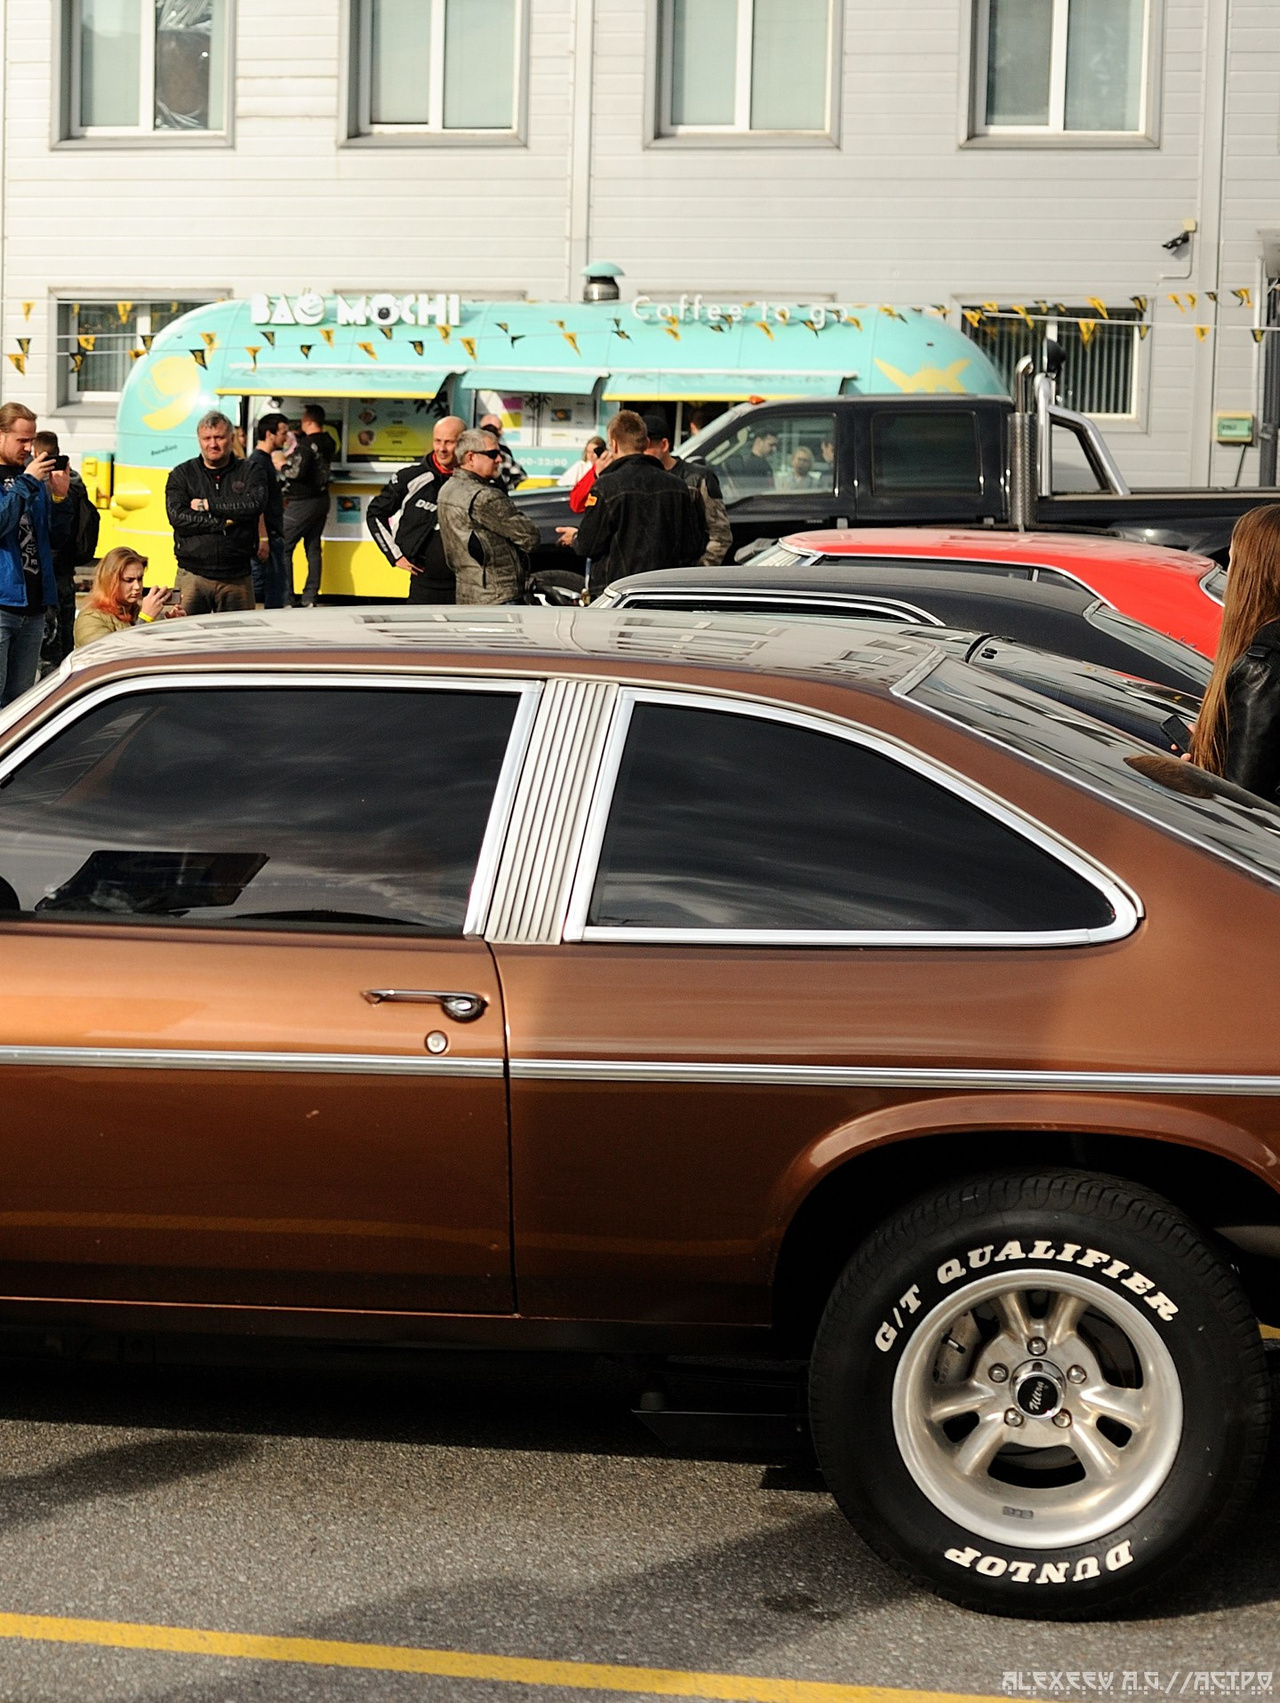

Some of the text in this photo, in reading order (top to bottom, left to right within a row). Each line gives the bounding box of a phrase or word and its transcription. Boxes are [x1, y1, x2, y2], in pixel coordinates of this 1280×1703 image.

[337, 293, 461, 326] MOCHI
[631, 294, 849, 330] Coffee to go
[873, 1240, 1179, 1352] G/T QUALIFIER
[943, 1539, 1135, 1584] DUNLOP
